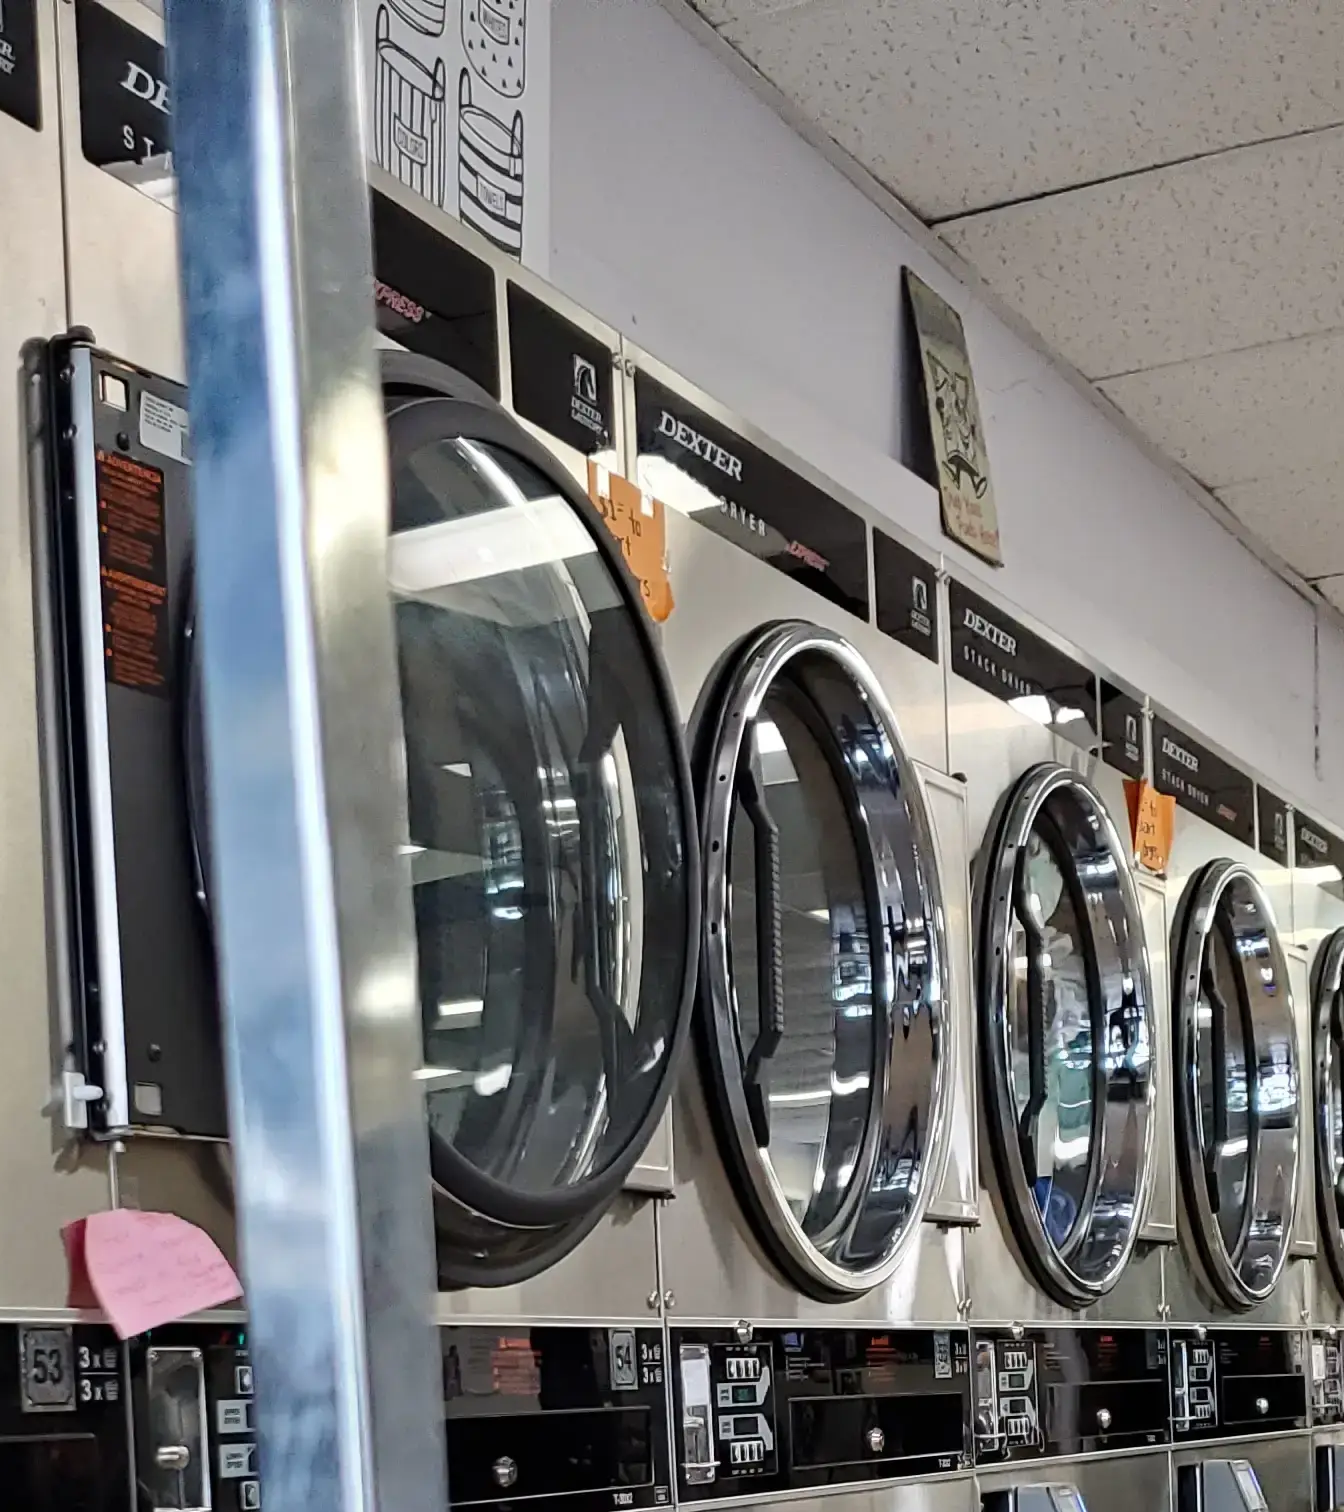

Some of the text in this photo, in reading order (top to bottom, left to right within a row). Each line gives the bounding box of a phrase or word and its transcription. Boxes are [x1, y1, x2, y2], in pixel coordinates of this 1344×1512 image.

[571, 396, 604, 425] DEXTER
[658, 410, 743, 481] DEXTER
[963, 608, 1016, 656] DEXTER
[964, 645, 1032, 696] STACK DRYER
[1161, 738, 1199, 773] DEXTER
[32, 1348, 63, 1386] 53
